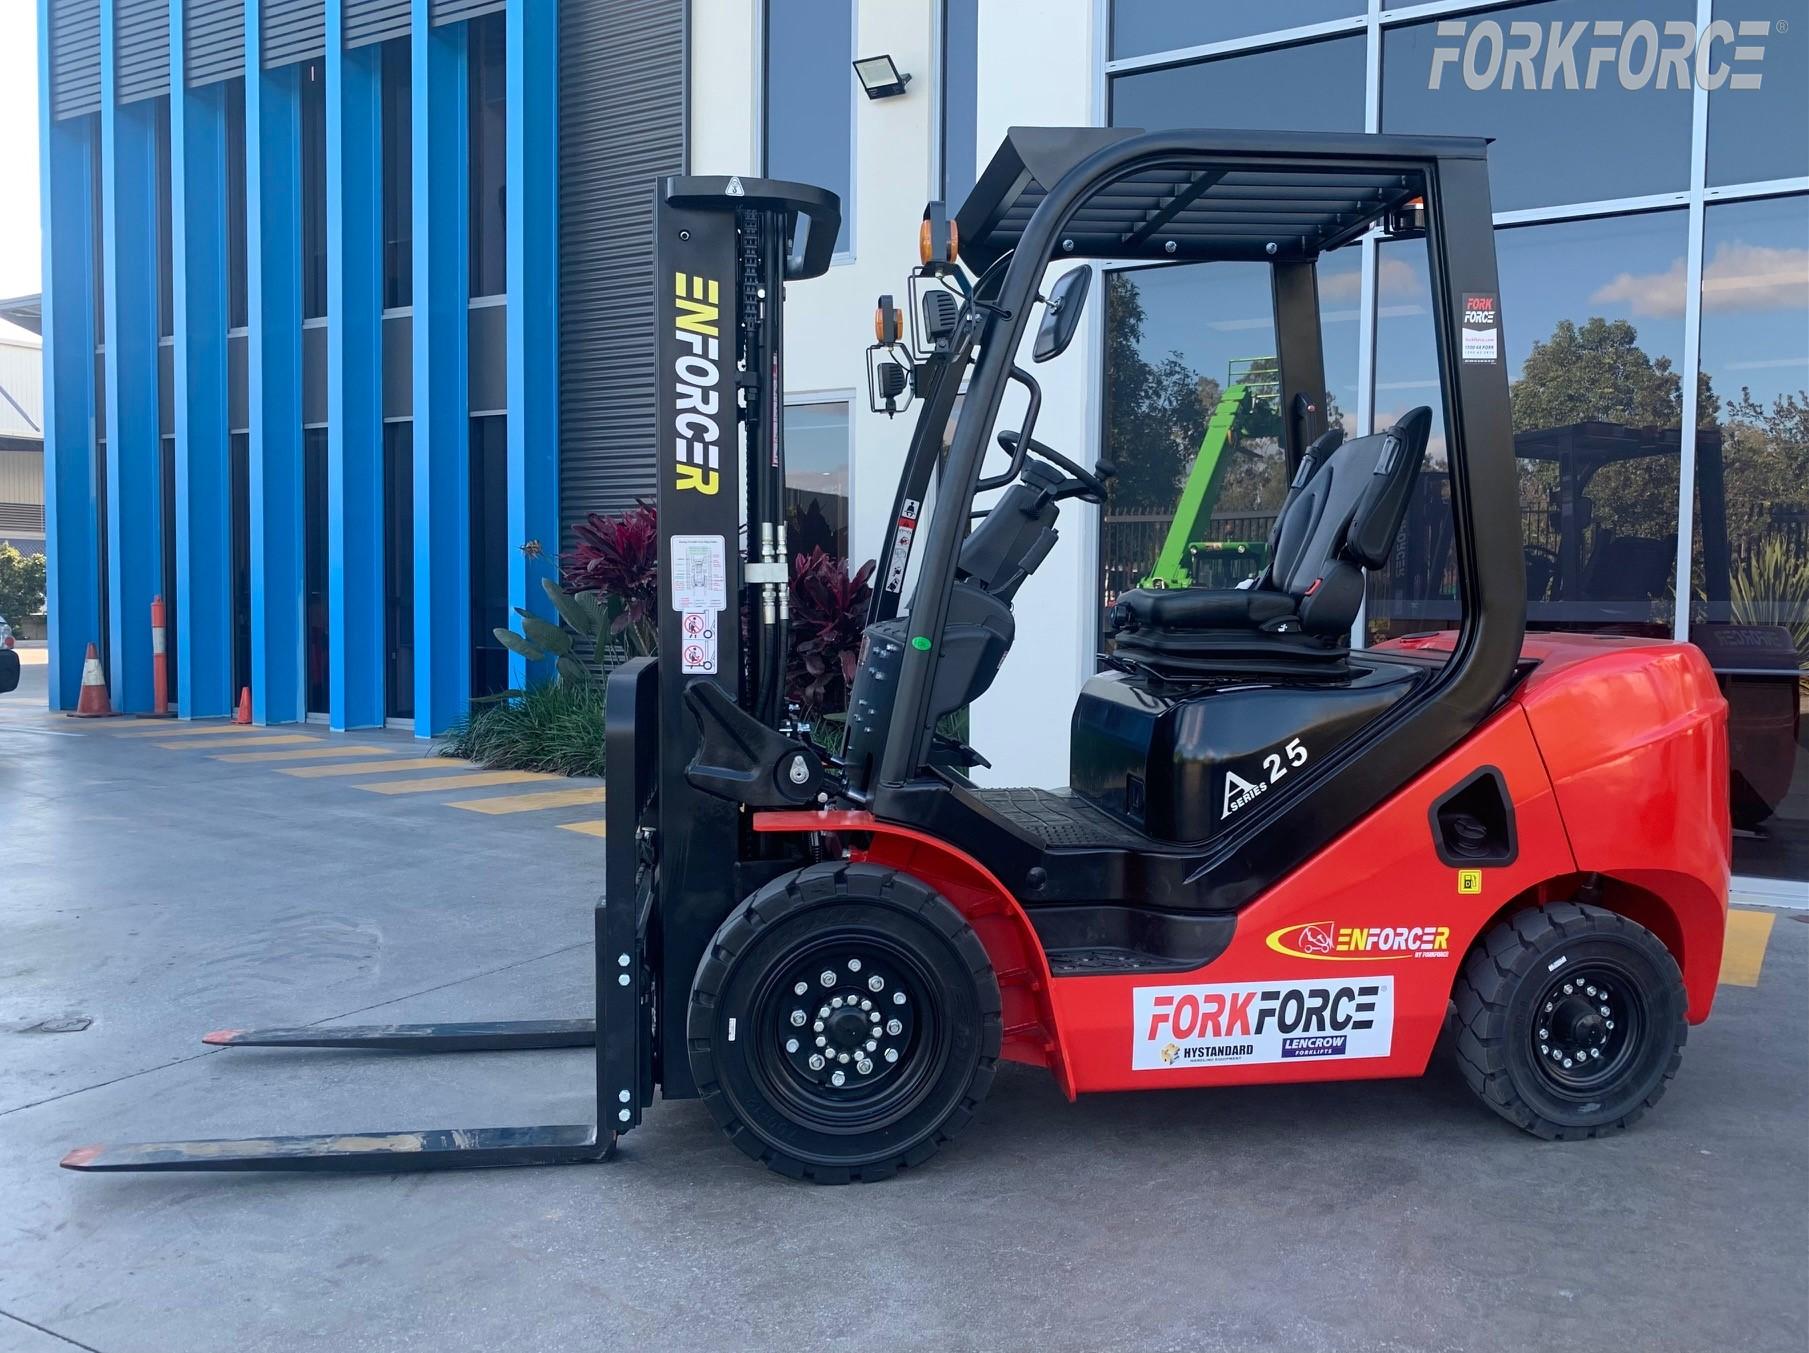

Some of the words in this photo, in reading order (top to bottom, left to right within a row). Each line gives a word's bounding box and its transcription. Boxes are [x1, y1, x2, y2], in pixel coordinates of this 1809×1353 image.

[1467, 298, 1493, 310] FORK
[1464, 311, 1496, 323] FORCE
[675, 271, 720, 495] ENFORCER
[1263, 738, 1308, 784] 25
[1221, 771, 1257, 820] A
[1230, 782, 1267, 812] SERIES
[1336, 927, 1450, 951] ENFORCER
[1184, 1044, 1254, 1059] HYSTANDARD
[1285, 1037, 1345, 1050] LENCROW
